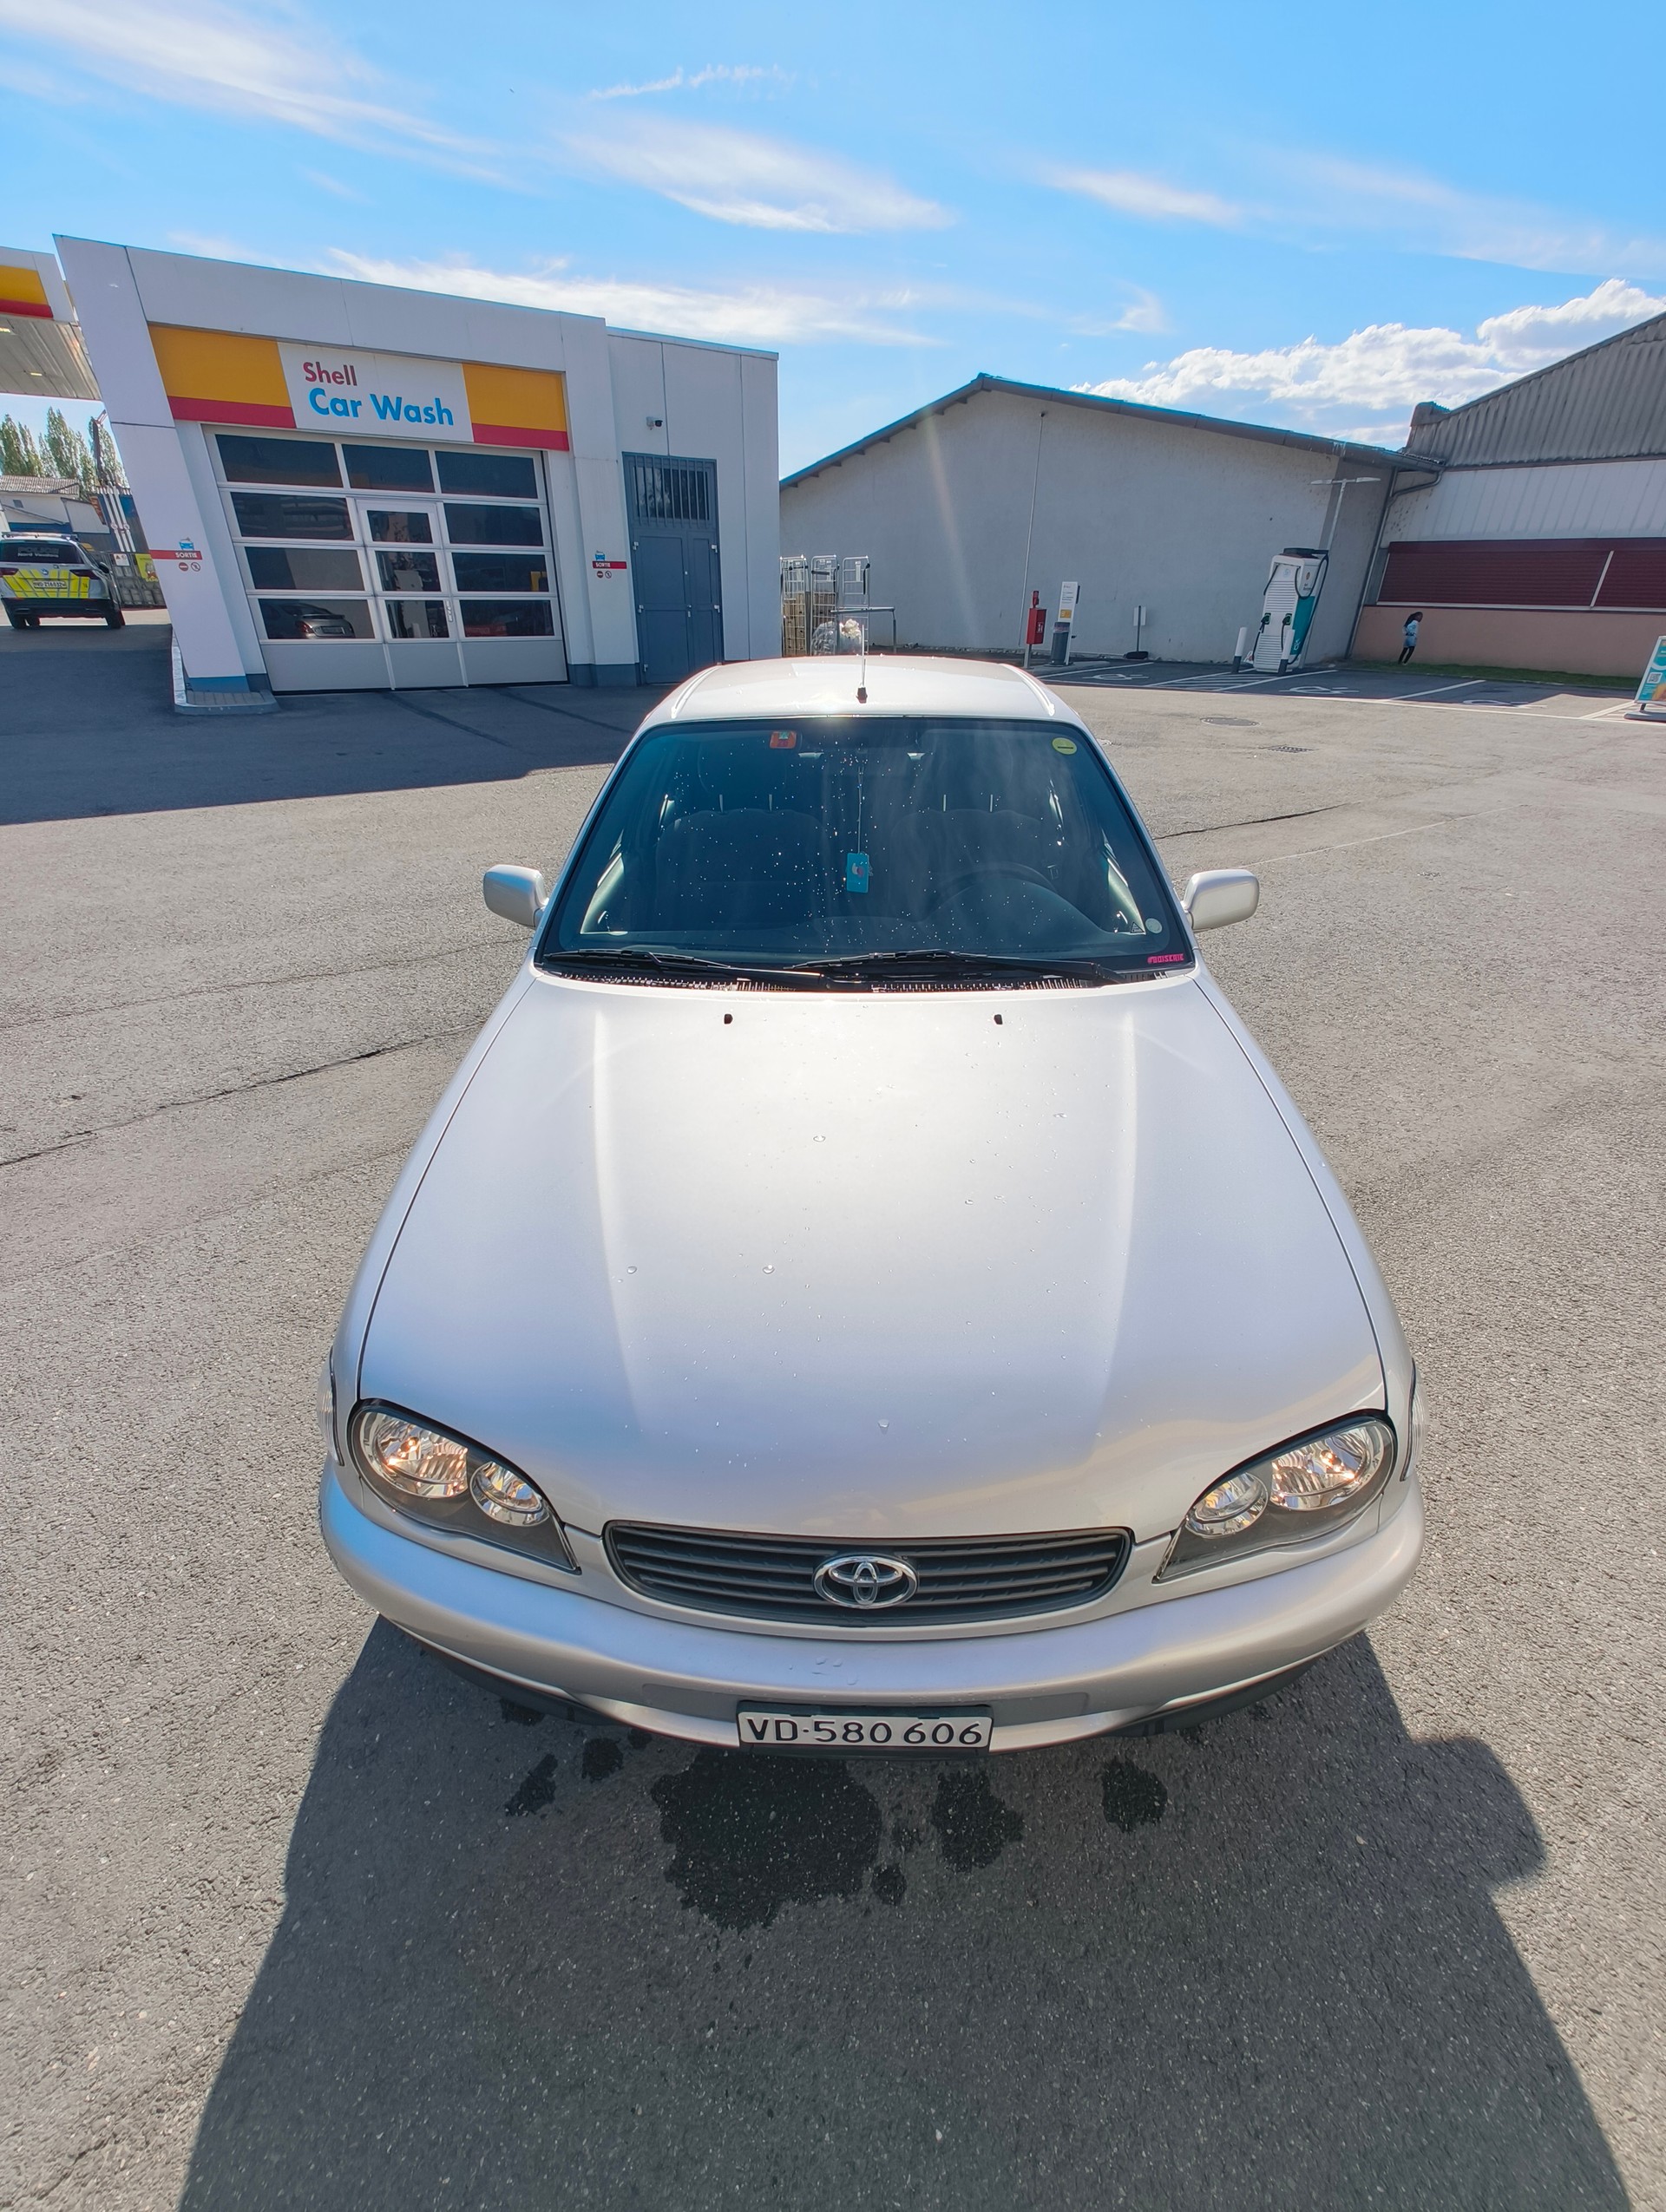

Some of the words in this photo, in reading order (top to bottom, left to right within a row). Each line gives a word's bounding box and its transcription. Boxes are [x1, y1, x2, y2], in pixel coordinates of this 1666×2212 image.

[303, 361, 357, 387] Shell
[308, 387, 362, 418] Car
[369, 393, 454, 426] Wash
